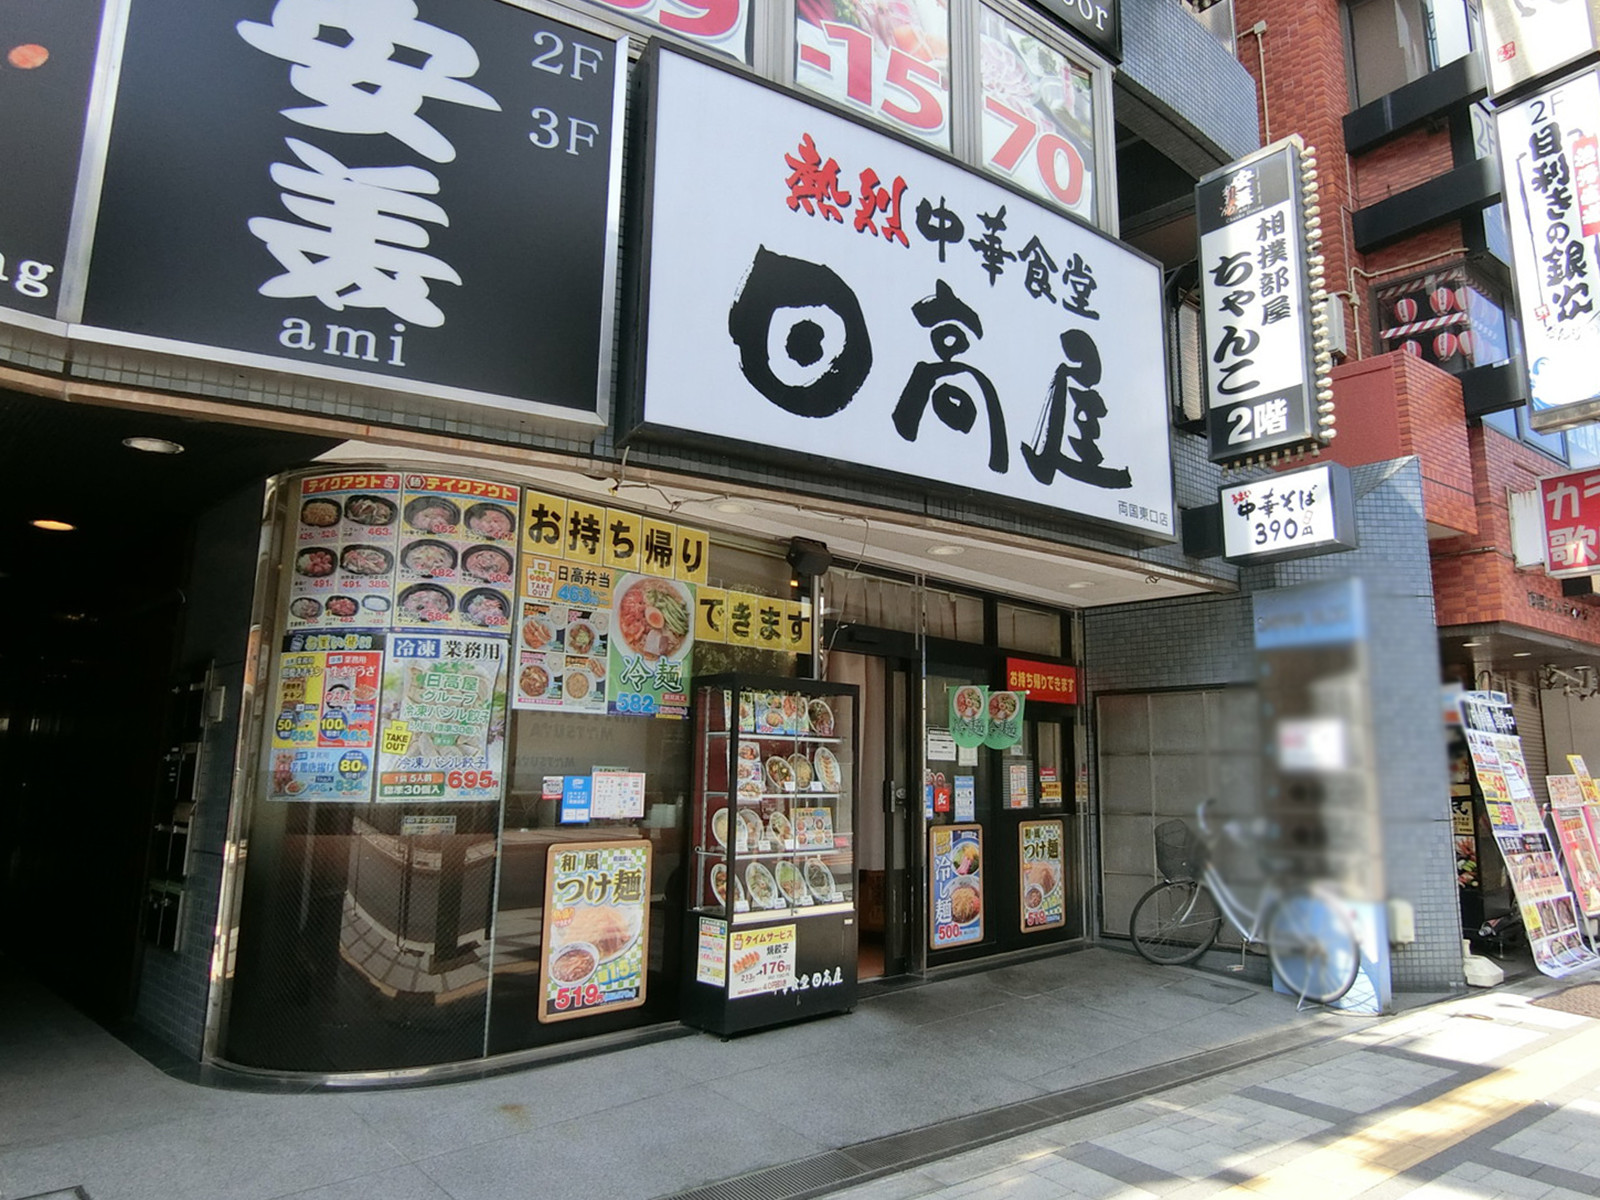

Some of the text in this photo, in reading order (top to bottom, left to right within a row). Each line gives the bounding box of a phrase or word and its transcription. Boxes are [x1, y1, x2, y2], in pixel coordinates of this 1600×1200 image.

[1062, 0, 1108, 31] or
[530, 30, 604, 82] 2F
[1529, 90, 1565, 126] 2F
[528, 106, 600, 157] 3F
[983, 96, 1085, 208] 70
[784, 131, 1101, 321] 熱烈中華食堂
[1528, 120, 1595, 324] 目利きの銀次
[1256, 209, 1292, 327] 相撲部屋
[1208, 250, 1261, 396] ちゃんこ
[279, 316, 406, 367] ami
[728, 243, 1133, 489] 日高屋
[1226, 397, 1288, 446] 2階
[308, 475, 381, 493] テイクアウト
[425, 477, 513, 499] テイクアウト
[1117, 500, 1170, 528] 両国東口店
[1237, 484, 1318, 521] 中華そば
[530, 503, 703, 573] お持ち帰り
[1254, 517, 1314, 546] 390円
[531, 582, 550, 591] TAKE
[558, 565, 611, 588] 日高弁当
[532, 589, 548, 597] OUT
[699, 596, 811, 645] できます
[396, 639, 500, 660] 冷凍 業務用
[425, 673, 479, 692] 日高屋
[619, 653, 683, 692] 冷麺
[1009, 671, 1075, 693] お持ち帰りできます
[422, 690, 477, 705] グループ
[404, 703, 490, 723] 冷凍バジル餃子
[385, 743, 406, 752] OUT
[386, 733, 408, 743] TAKE
[396, 756, 487, 769] 冷凍バジル餃子
[447, 770, 499, 789] 695円
[561, 853, 600, 872] 和風
[1024, 838, 1059, 860] つけ麺
[557, 867, 643, 904] つけ麺
[935, 856, 953, 926] 冷し麺
[745, 929, 793, 945] タイムサービス
[766, 942, 789, 955] 焼餃子
[761, 960, 791, 975] 176円
[554, 983, 605, 1010] 519円
